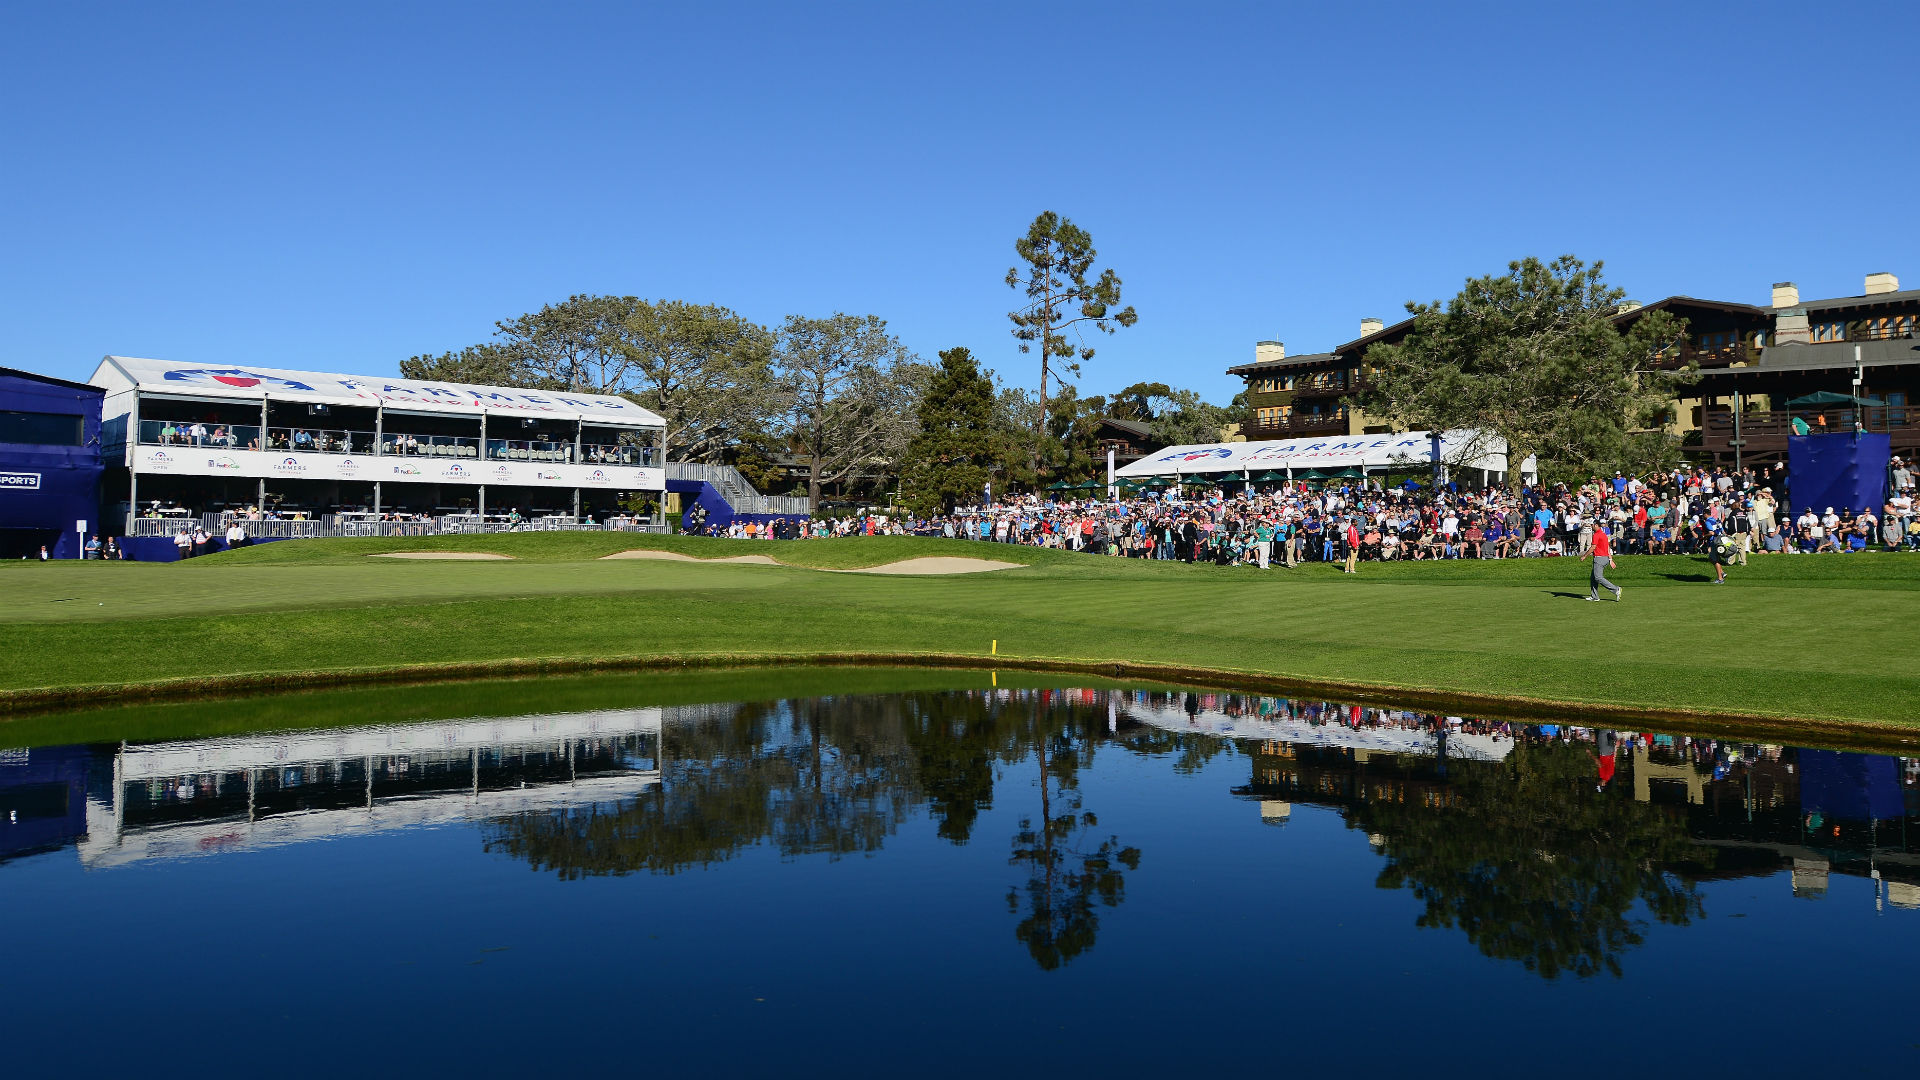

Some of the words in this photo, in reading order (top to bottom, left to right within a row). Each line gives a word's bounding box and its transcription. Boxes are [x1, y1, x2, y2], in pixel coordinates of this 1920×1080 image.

[337, 380, 624, 409] FARMERS
[1240, 450, 1367, 461] INSURANCE
[0, 476, 36, 485] PORTS
